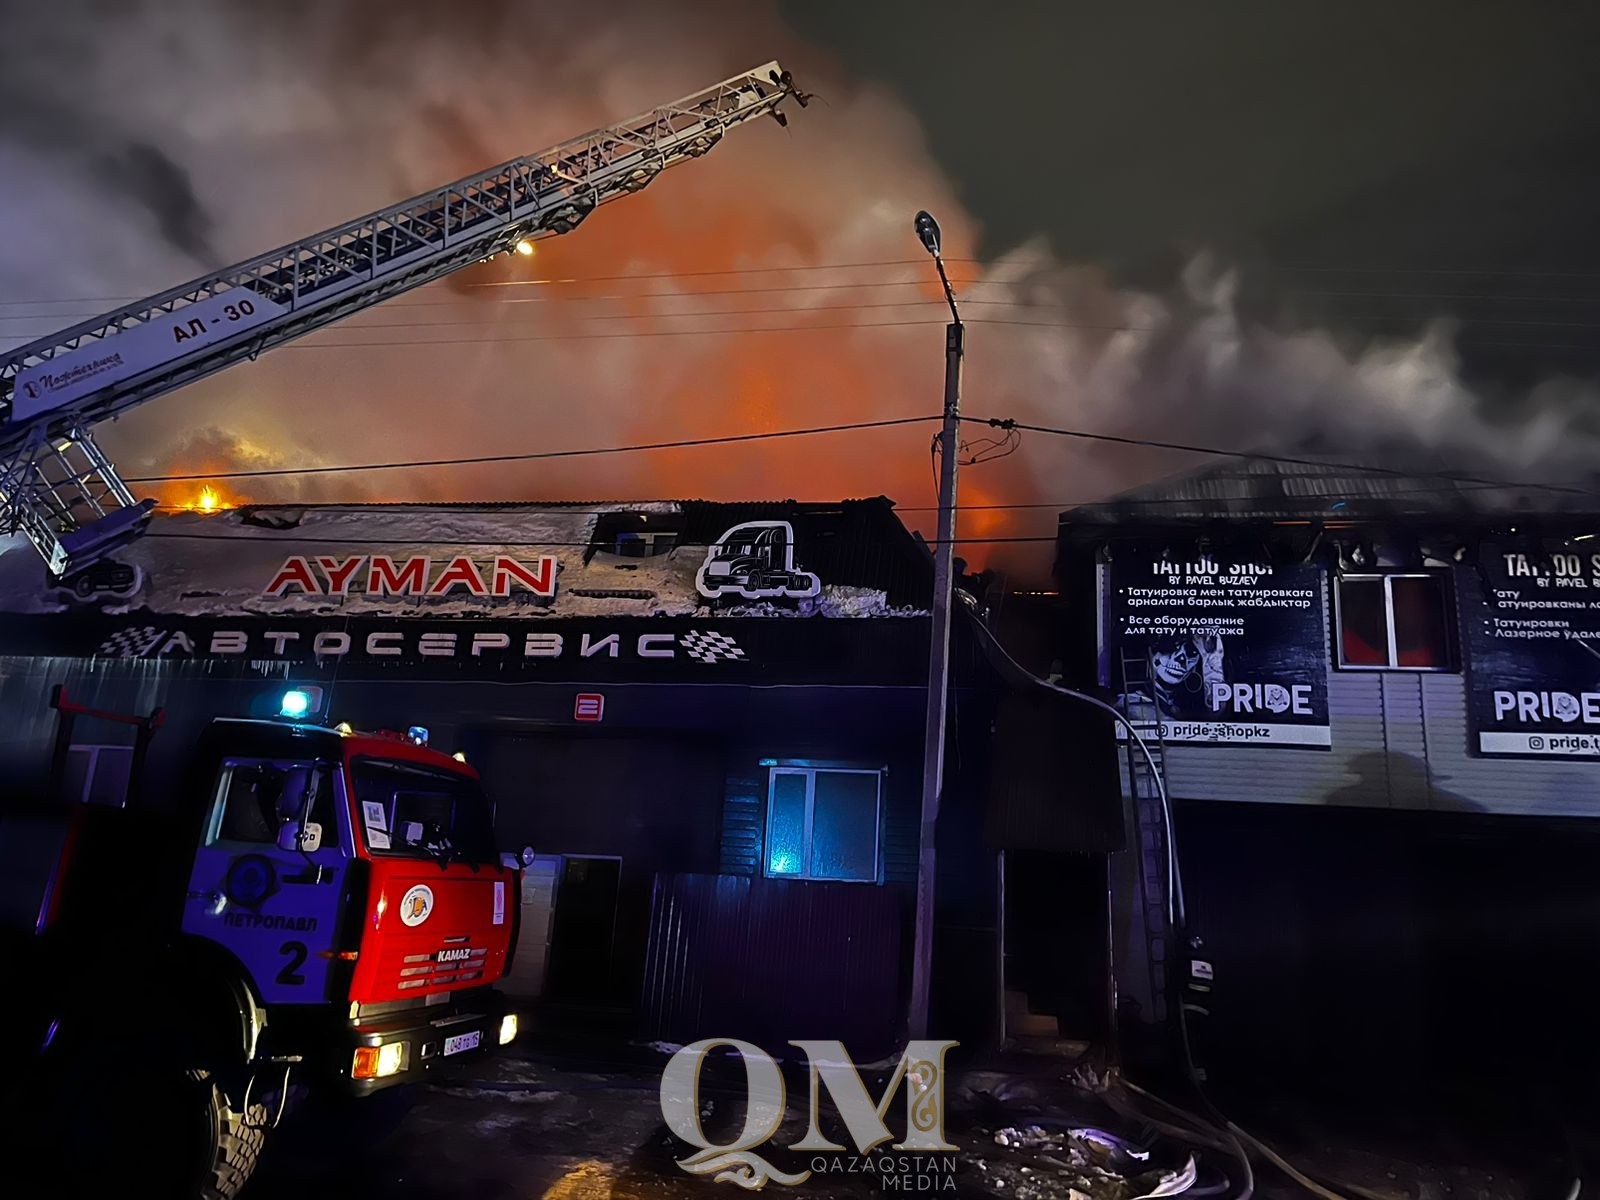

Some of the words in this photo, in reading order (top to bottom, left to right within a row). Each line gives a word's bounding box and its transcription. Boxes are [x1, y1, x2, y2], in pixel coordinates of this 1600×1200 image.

[173, 318, 207, 343] АЛ
[223, 300, 255, 322] 30
[1229, 563, 1273, 575] SHO
[1503, 554, 1580, 576] TAOO
[265, 555, 558, 598] AYMAN
[1169, 576, 1180, 585] BY
[1186, 576, 1214, 585] PAVEL
[1537, 578, 1549, 587] BY
[1555, 578, 1588, 588] PAVEL
[1128, 588, 1197, 598] Татуировка
[1227, 590, 1313, 599] татуировкаға
[1493, 589, 1520, 600] ату
[1128, 599, 1184, 608] арналған
[1188, 598, 1235, 608] барлық
[1238, 598, 1311, 609] жабдықтар
[1498, 601, 1586, 610] атуировканы
[1129, 616, 1151, 625] Все
[1154, 616, 1245, 627] оборудование
[1494, 618, 1569, 629] Татуировки
[1125, 627, 1146, 635] для
[1149, 627, 1176, 637] тату
[1180, 627, 1187, 635] и
[1190, 626, 1244, 637] татуажа
[1495, 629, 1560, 639] Лазерное
[158, 631, 675, 658] АВТОСЕРВИС
[1212, 683, 1313, 715] PRIDE
[1494, 691, 1600, 723] PRIDE
[224, 912, 317, 932] ПЕТРОПАВЛ
[437, 948, 471, 962] KAMAZ
[276, 941, 307, 985] 2
